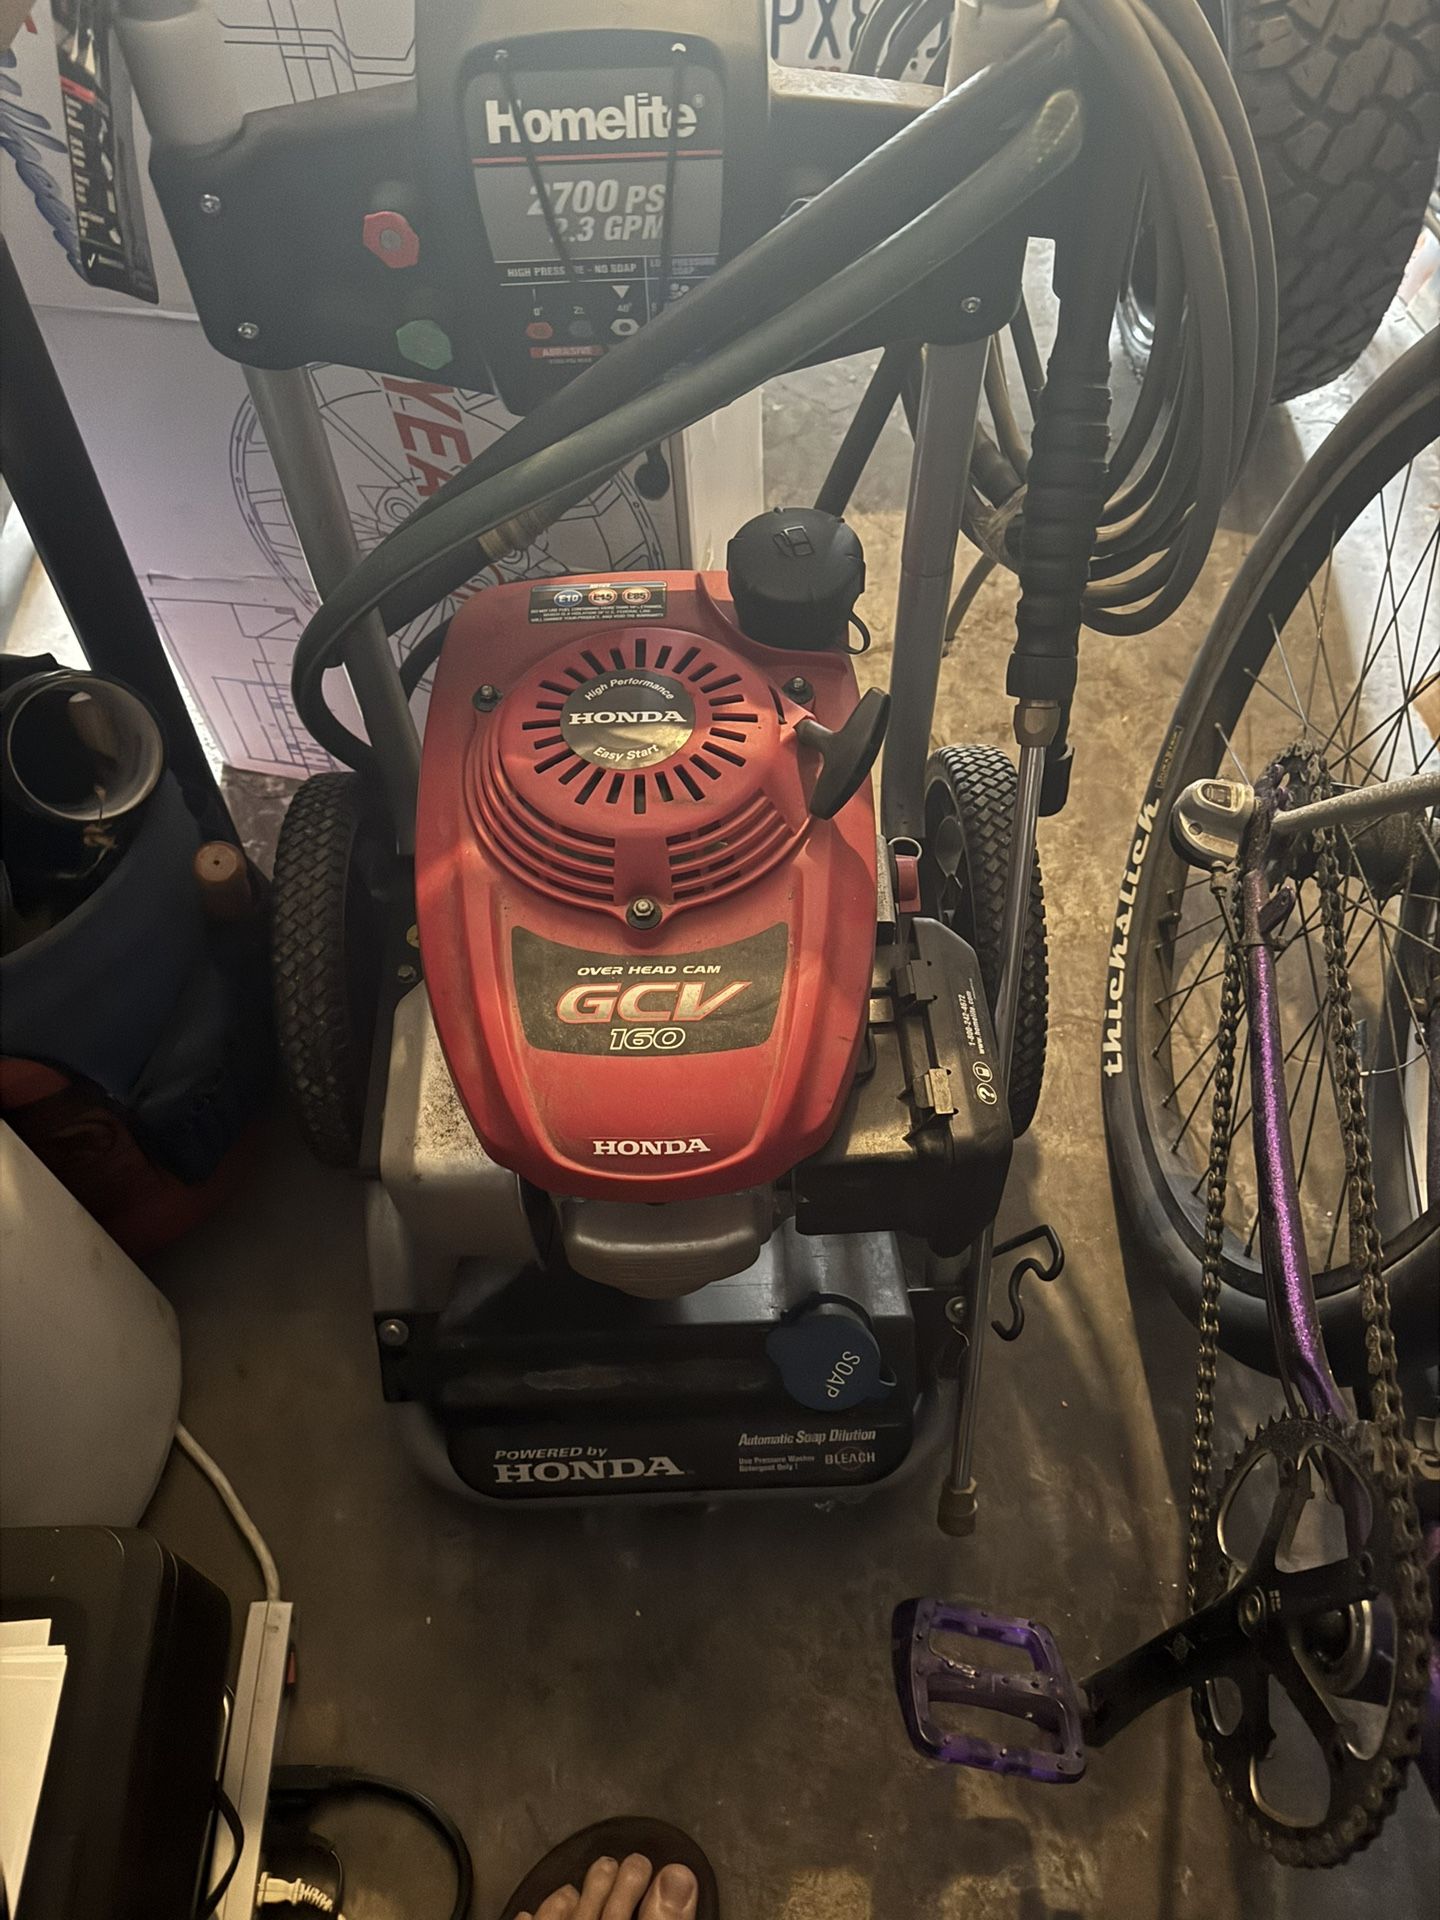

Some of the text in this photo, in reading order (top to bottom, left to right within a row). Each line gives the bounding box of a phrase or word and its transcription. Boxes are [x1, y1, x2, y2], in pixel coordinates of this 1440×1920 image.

[485, 92, 698, 144] Homelite
[526, 179, 668, 216] 2700 PS
[507, 267, 531, 277] HIGH
[534, 265, 584, 277] PRESSE
[558, 593, 579, 603] E10
[584, 677, 675, 701] High Performance
[568, 710, 687, 725] HONDA
[593, 743, 659, 761] Easy Start
[577, 965, 722, 976] OVER HEAD CAM
[556, 981, 753, 1024] GCV
[610, 1027, 686, 1050] 160
[593, 1138, 711, 1156] HONDA
[825, 1351, 860, 1398] SOAP
[738, 1429, 876, 1446] Automatic Soap Dilution
[494, 1446, 608, 1460] POWERED by
[825, 1452, 875, 1465] BLEACH
[493, 1456, 685, 1483] HONDA
